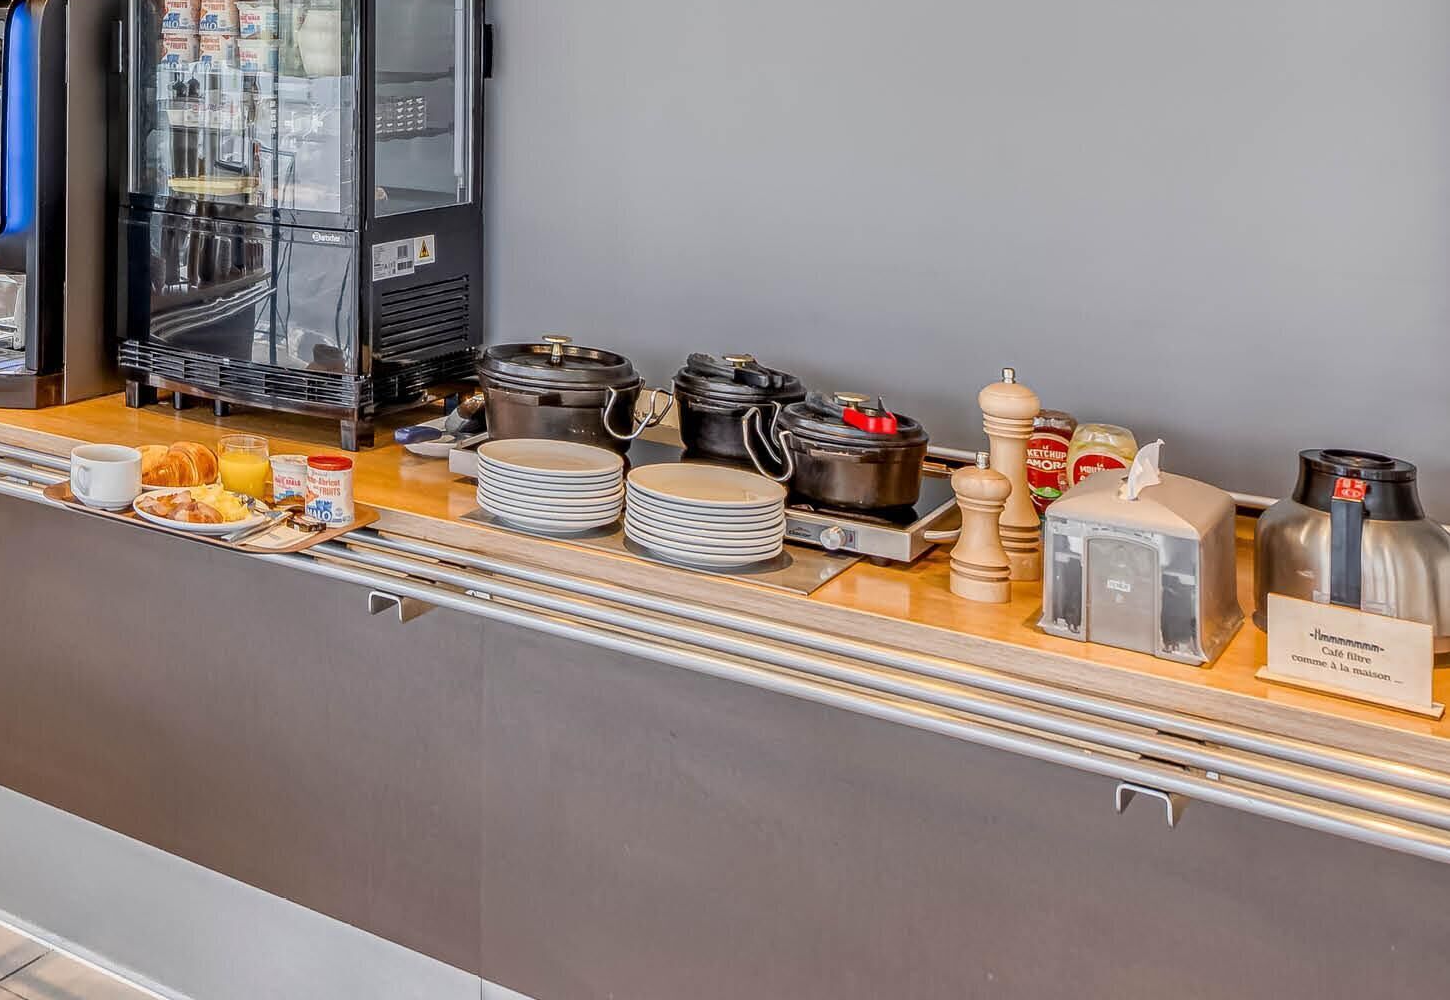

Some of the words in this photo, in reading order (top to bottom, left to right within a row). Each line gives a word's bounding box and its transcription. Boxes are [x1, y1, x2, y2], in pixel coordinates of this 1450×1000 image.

[1026, 448, 1067, 460] KETCHUP
[1321, 646, 1344, 658] Café
[1347, 651, 1372, 665] filtre
[1291, 653, 1328, 668] comme
[1330, 660, 1337, 670] à
[1340, 662, 1350, 673] la
[1353, 666, 1392, 682] maison
